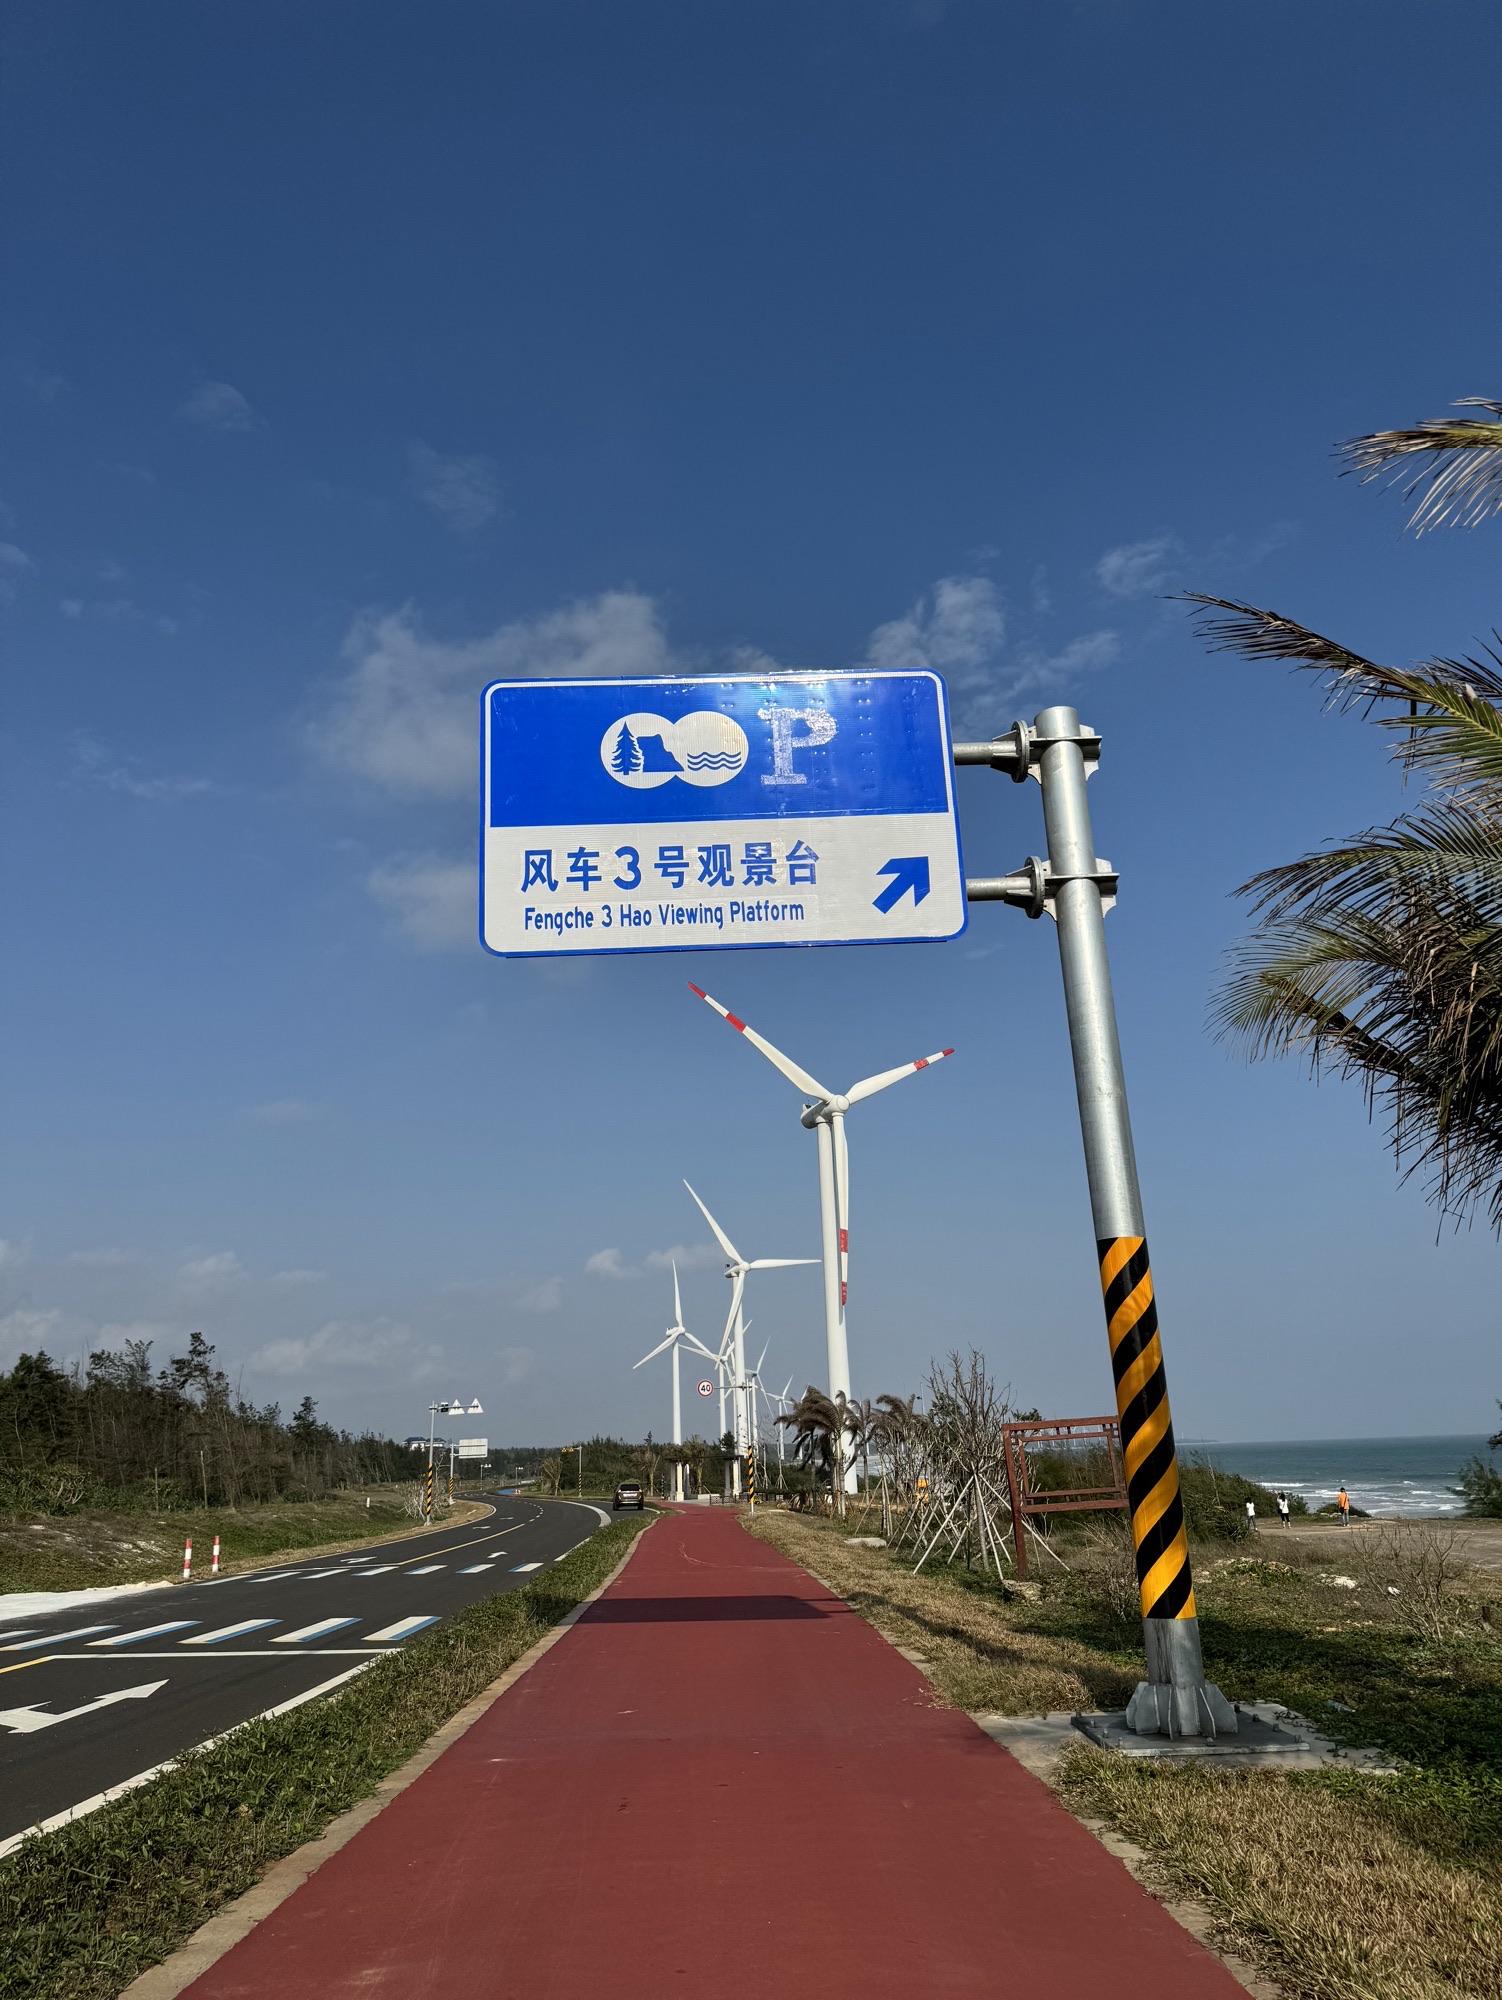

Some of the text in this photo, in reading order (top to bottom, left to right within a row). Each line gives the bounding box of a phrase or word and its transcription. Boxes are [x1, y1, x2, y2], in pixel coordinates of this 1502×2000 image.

[758, 707, 838, 785] P
[521, 840, 820, 892] 风车3号观景台
[524, 900, 805, 936] Fengche 3 Hao Viewing Platform
[701, 1384, 711, 1392] 40
